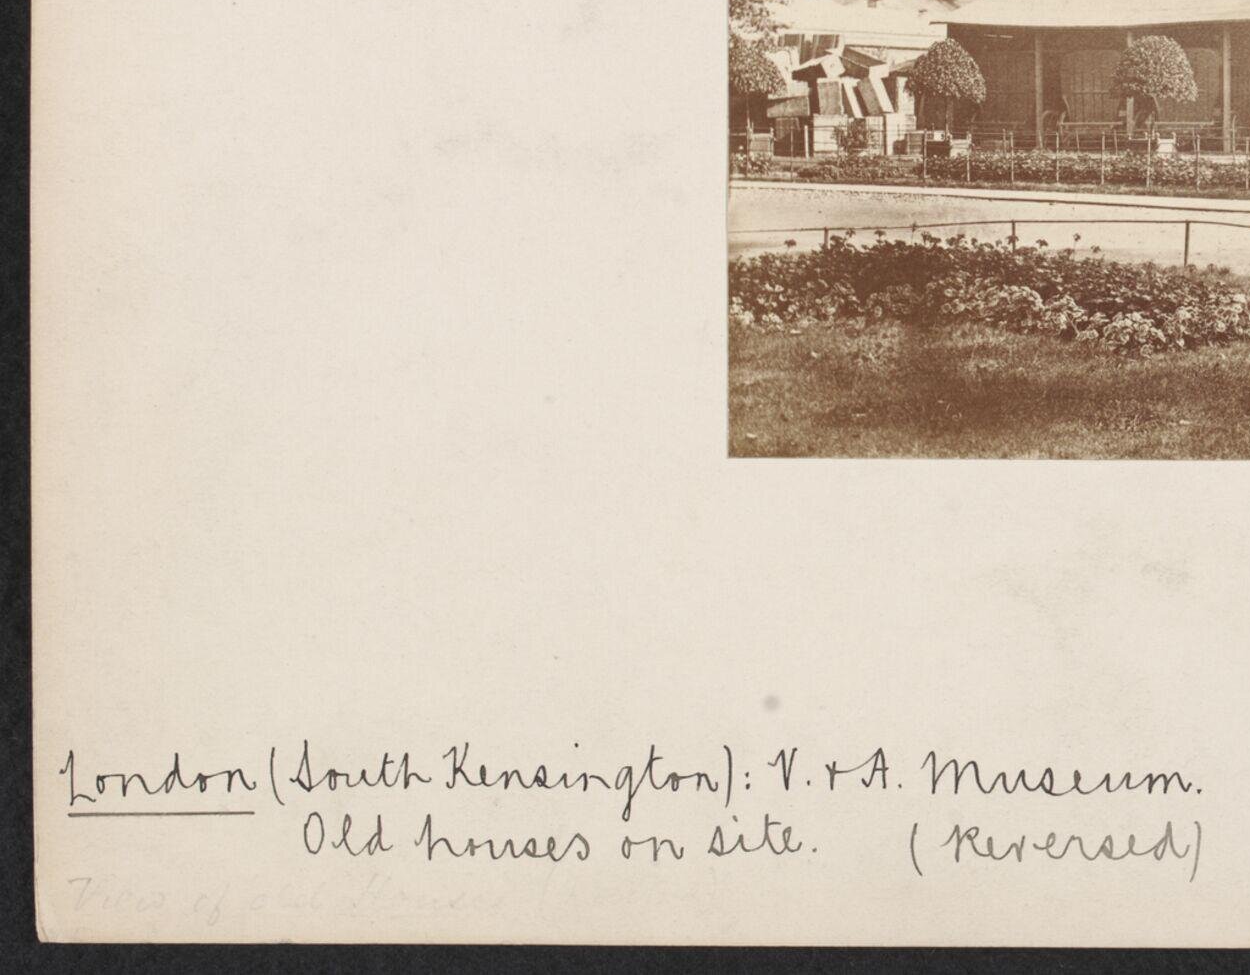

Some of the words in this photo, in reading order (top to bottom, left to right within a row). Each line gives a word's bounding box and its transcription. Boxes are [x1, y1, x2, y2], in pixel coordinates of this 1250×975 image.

[59, 750, 257, 806] London
[270, 739, 432, 806] (South
[442, 742, 750, 822] Kensington):
[920, 751, 1202, 796] Museum.
[304, 811, 393, 856] Old
[414, 814, 590, 862] houses
[621, 836, 684, 862] on
[708, 813, 817, 857] site.
